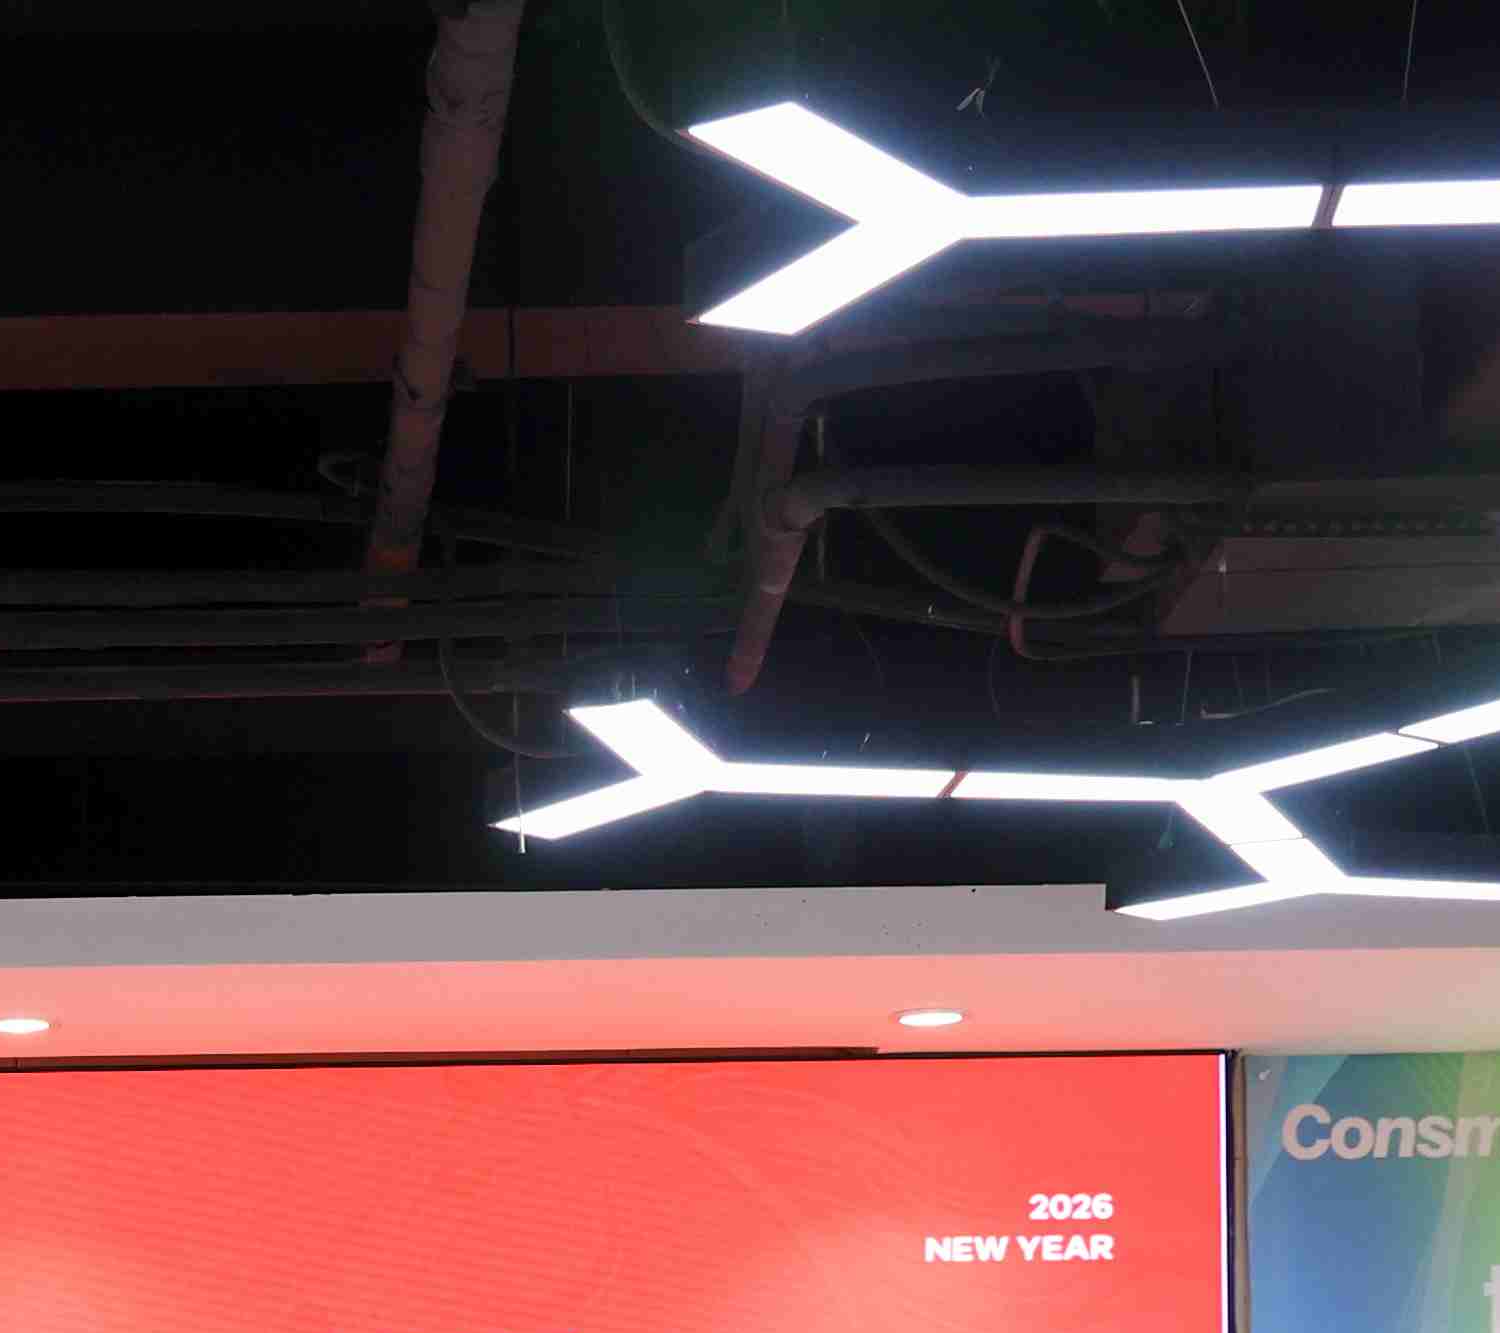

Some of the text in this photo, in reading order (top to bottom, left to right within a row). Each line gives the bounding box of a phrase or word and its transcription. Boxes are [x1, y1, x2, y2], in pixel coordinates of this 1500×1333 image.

[1027, 1193, 1113, 1221] 2026
[924, 1234, 1113, 1262] NEW YEAR
